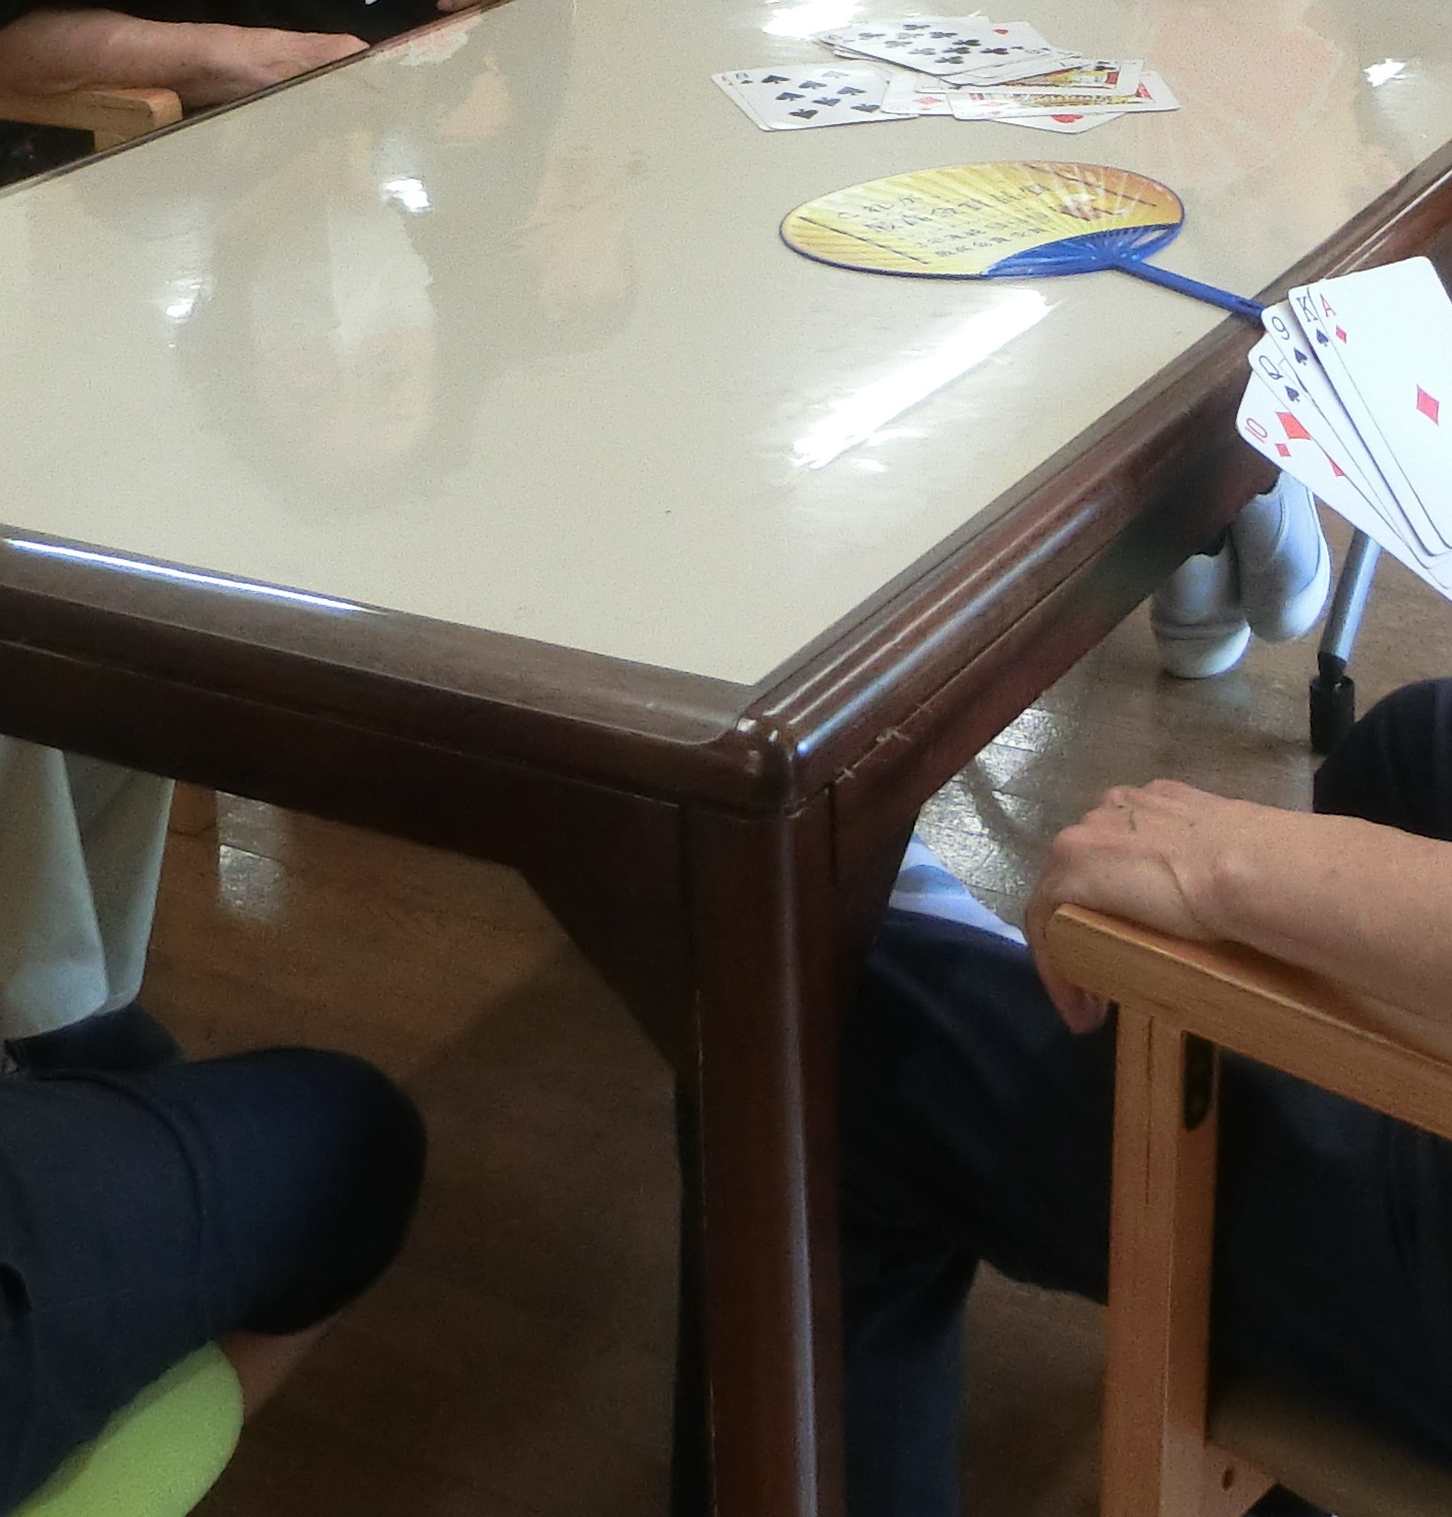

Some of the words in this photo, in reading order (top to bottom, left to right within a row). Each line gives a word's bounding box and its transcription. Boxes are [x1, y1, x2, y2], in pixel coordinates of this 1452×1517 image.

[1296, 296, 1318, 323] K
[1319, 293, 1337, 318] A
[1271, 316, 1290, 341] 9
[1258, 355, 1284, 380] Q
[1244, 417, 1268, 444] 10
